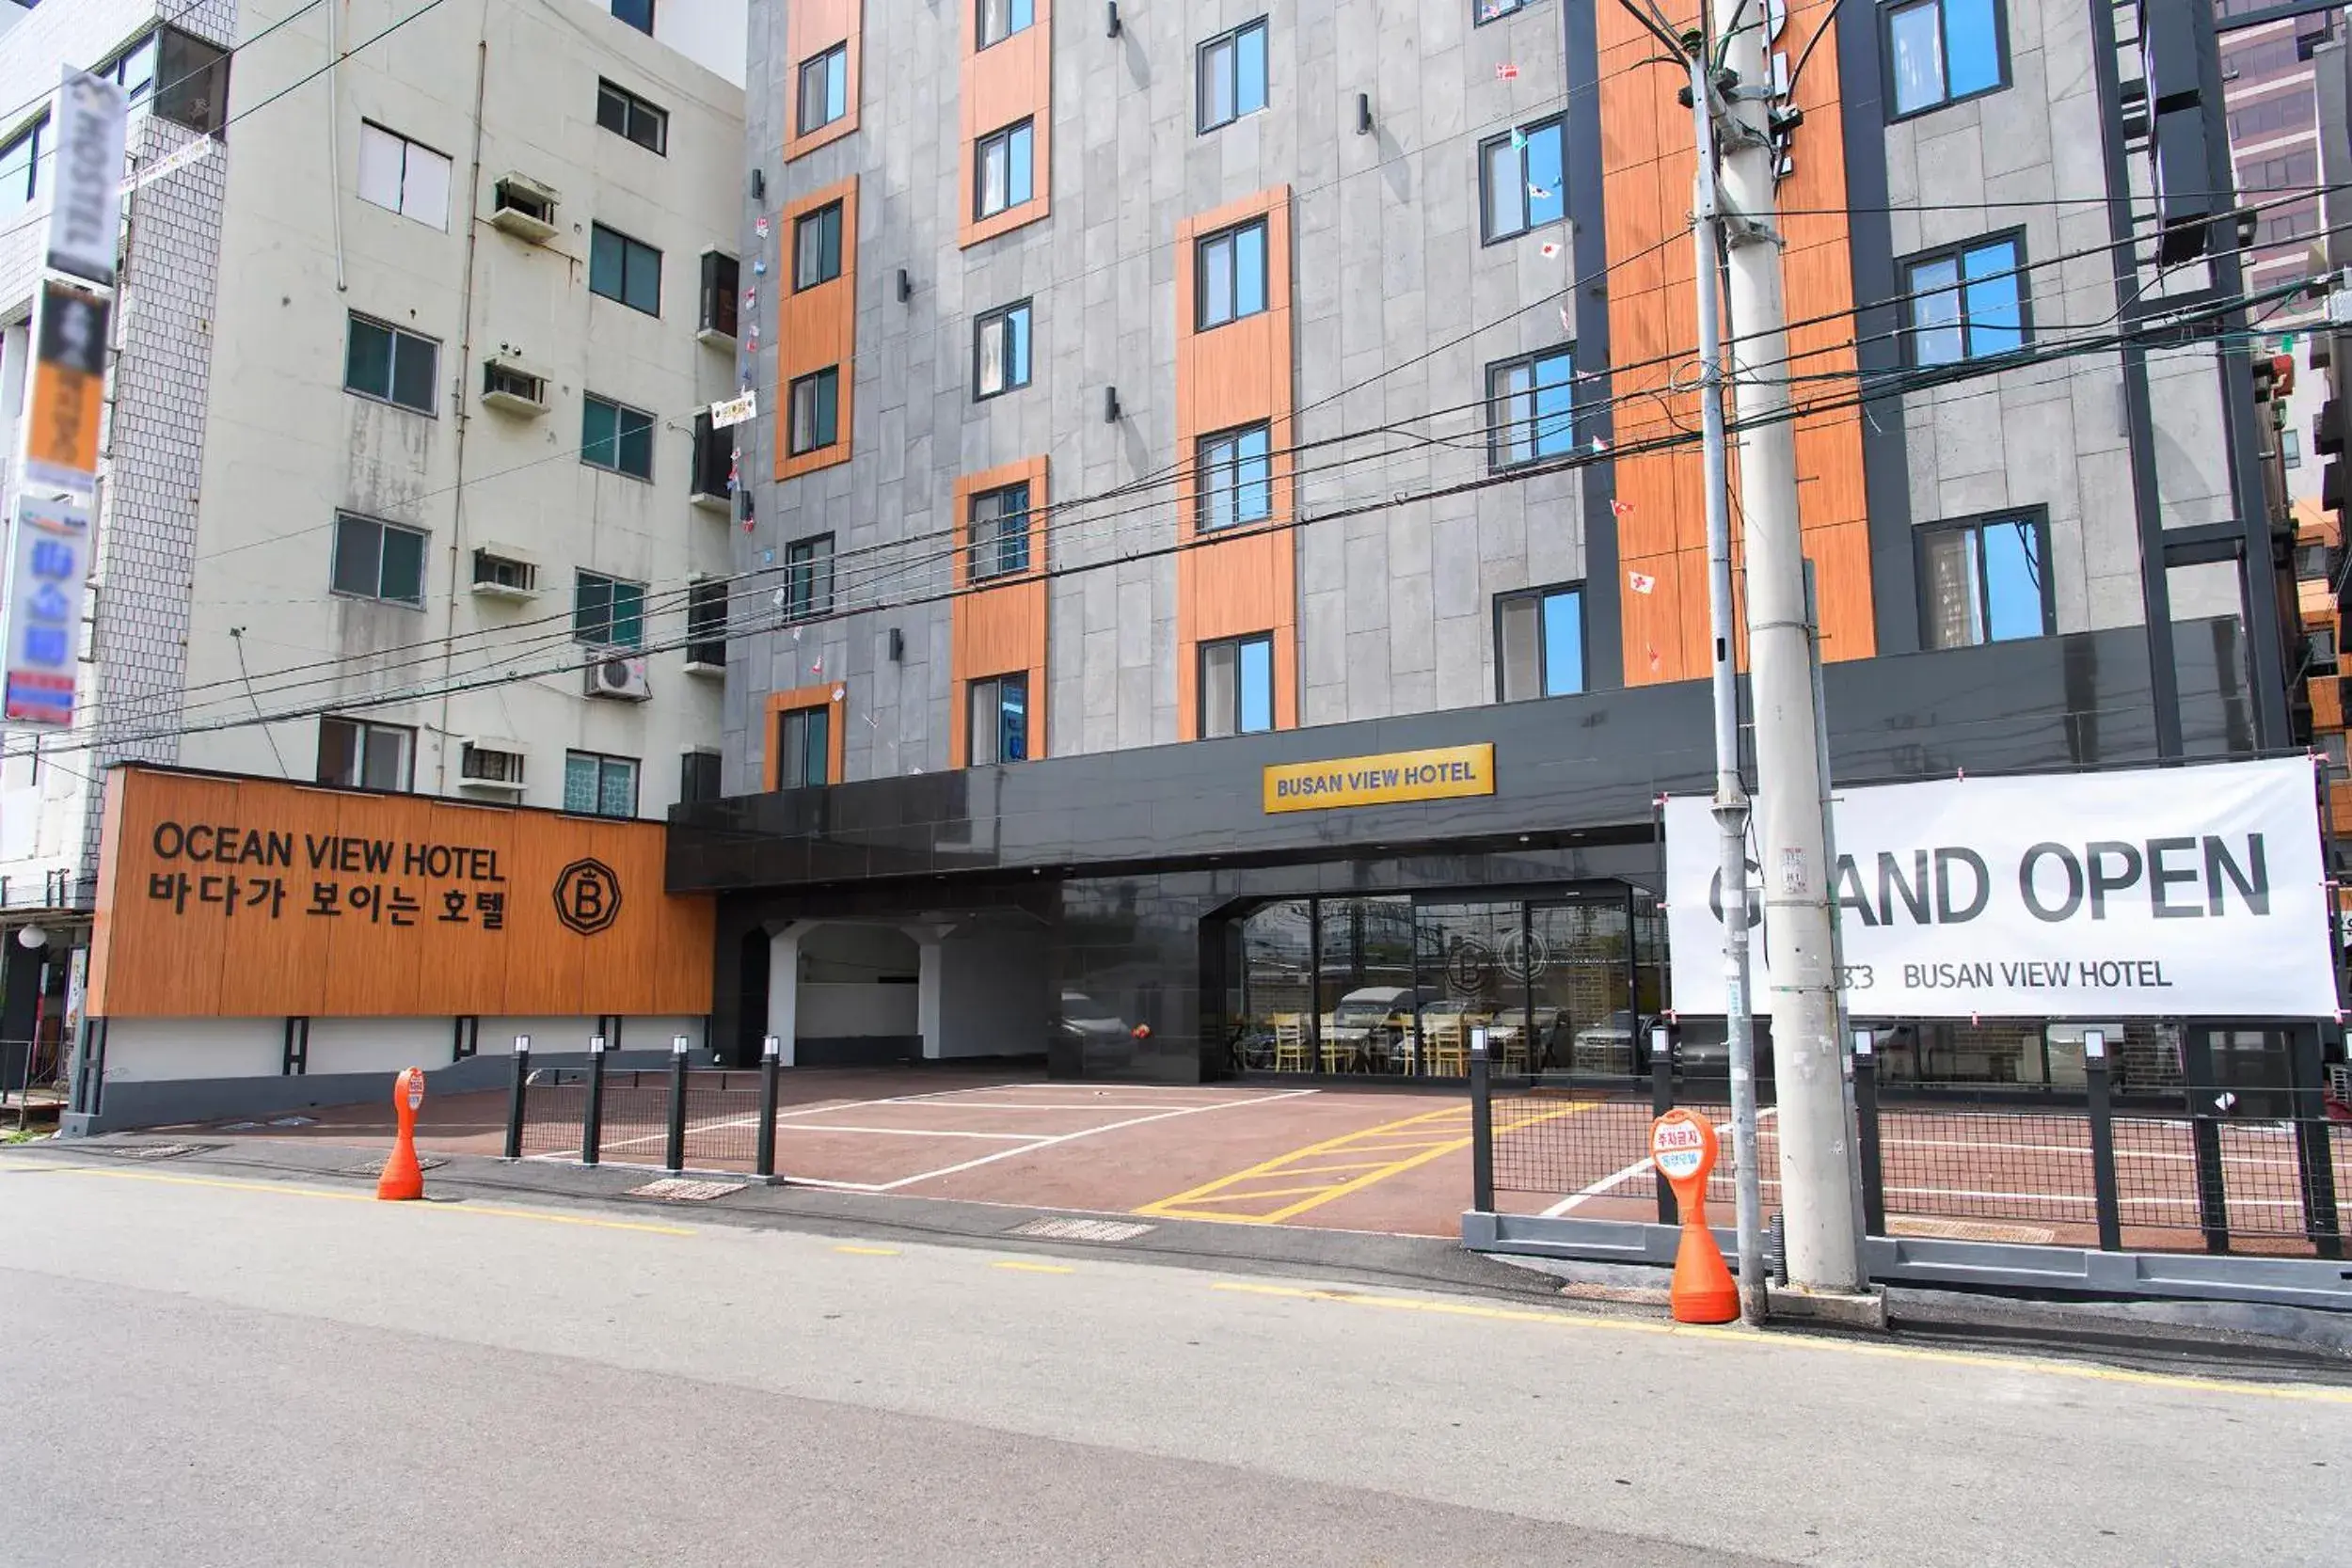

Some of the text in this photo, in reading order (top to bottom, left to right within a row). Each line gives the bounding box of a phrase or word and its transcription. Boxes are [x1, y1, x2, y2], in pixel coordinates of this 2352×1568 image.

[1278, 761, 1476, 798] BUSAN VIEW HOTEL
[153, 821, 505, 881] OCEAN VIEW HOTEL
[575, 879, 601, 918] B
[1709, 847, 1990, 928] GAND
[2019, 832, 2270, 923] OPEN
[149, 873, 504, 930] 바다가 보이는 호텔
[1904, 962, 1994, 989] BUSAN
[2000, 961, 2071, 988] VIEW
[2080, 960, 2172, 988] HOTEL
[1659, 1131, 1697, 1147] 주차금지
